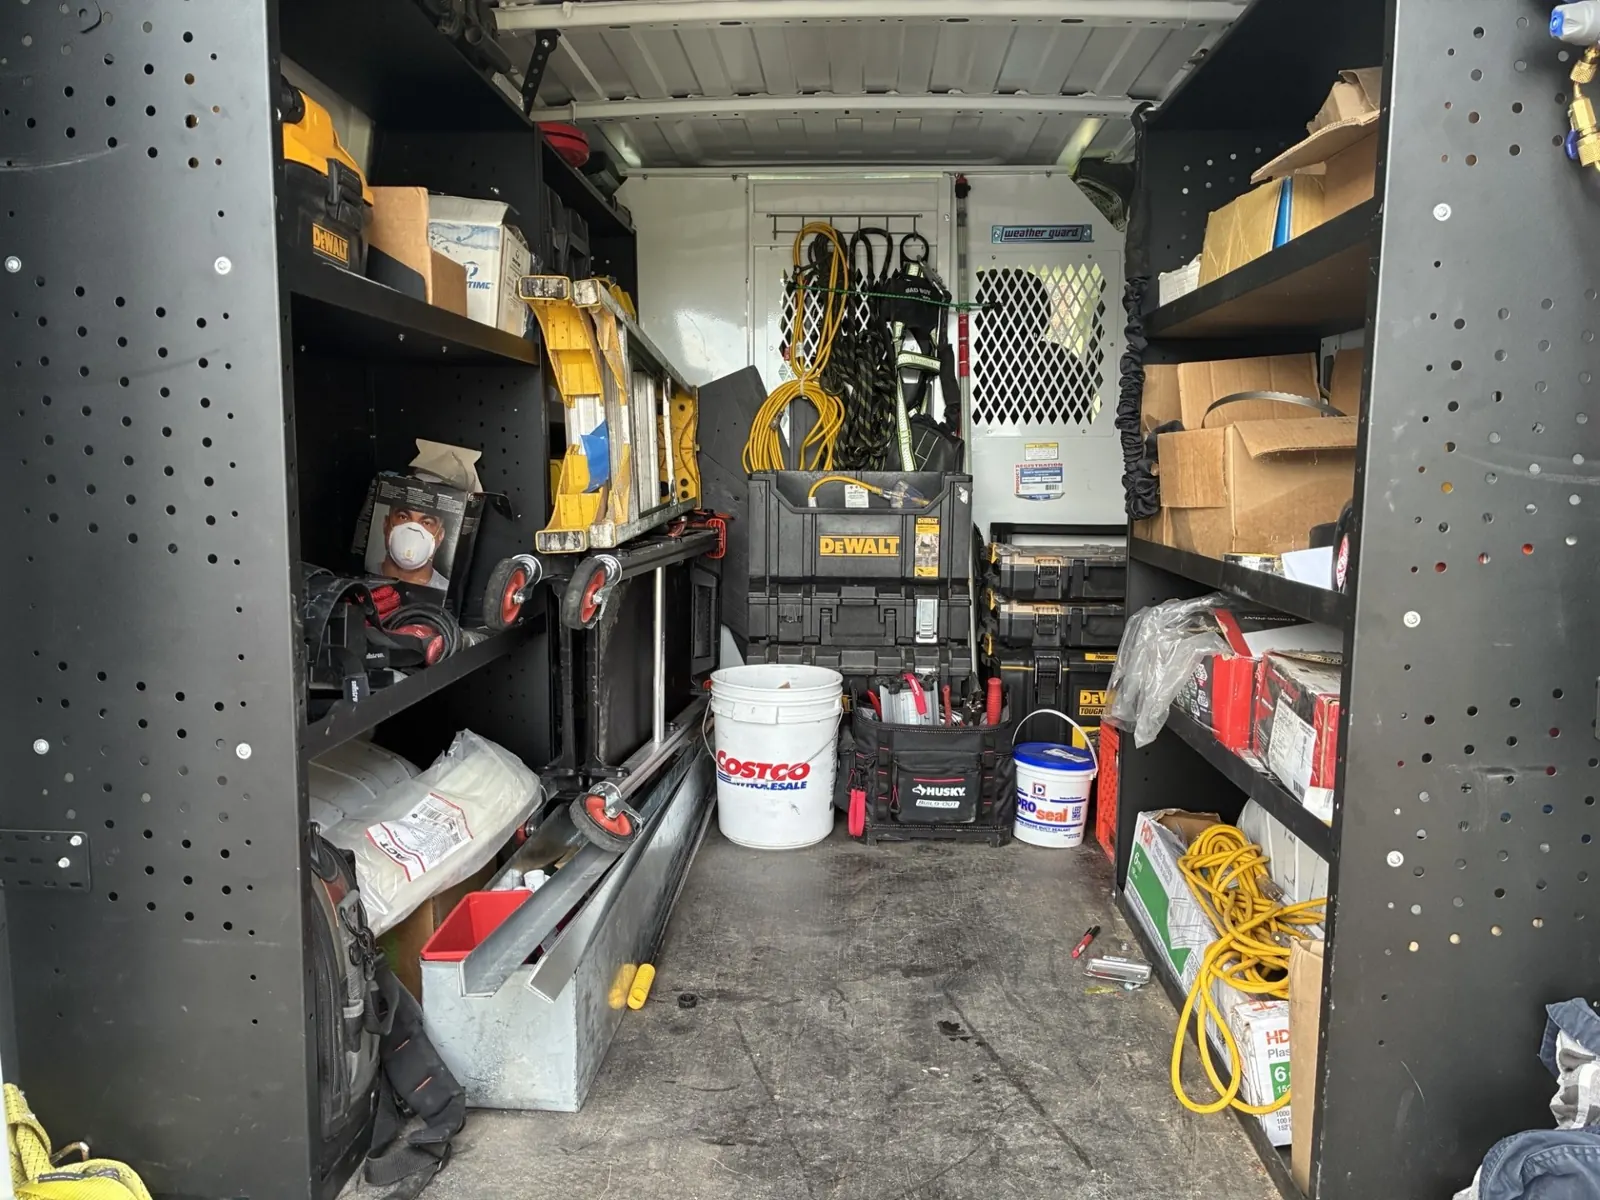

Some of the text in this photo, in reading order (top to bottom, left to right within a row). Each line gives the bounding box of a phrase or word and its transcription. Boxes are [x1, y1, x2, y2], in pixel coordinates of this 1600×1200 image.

[1004, 228, 1080, 239] weather guard
[467, 281, 492, 290] TIME
[820, 537, 898, 554] DEWALT
[1080, 706, 1104, 715] TOUGH
[717, 749, 811, 782] COSTCO
[734, 780, 808, 791] WHOLESALE
[926, 786, 966, 797] HUSKY
[1017, 796, 1037, 813] PRO
[1035, 807, 1068, 823] seal
[1265, 1029, 1290, 1045] HD
[1267, 1049, 1290, 1059] Plas
[1274, 1067, 1286, 1082] 6
